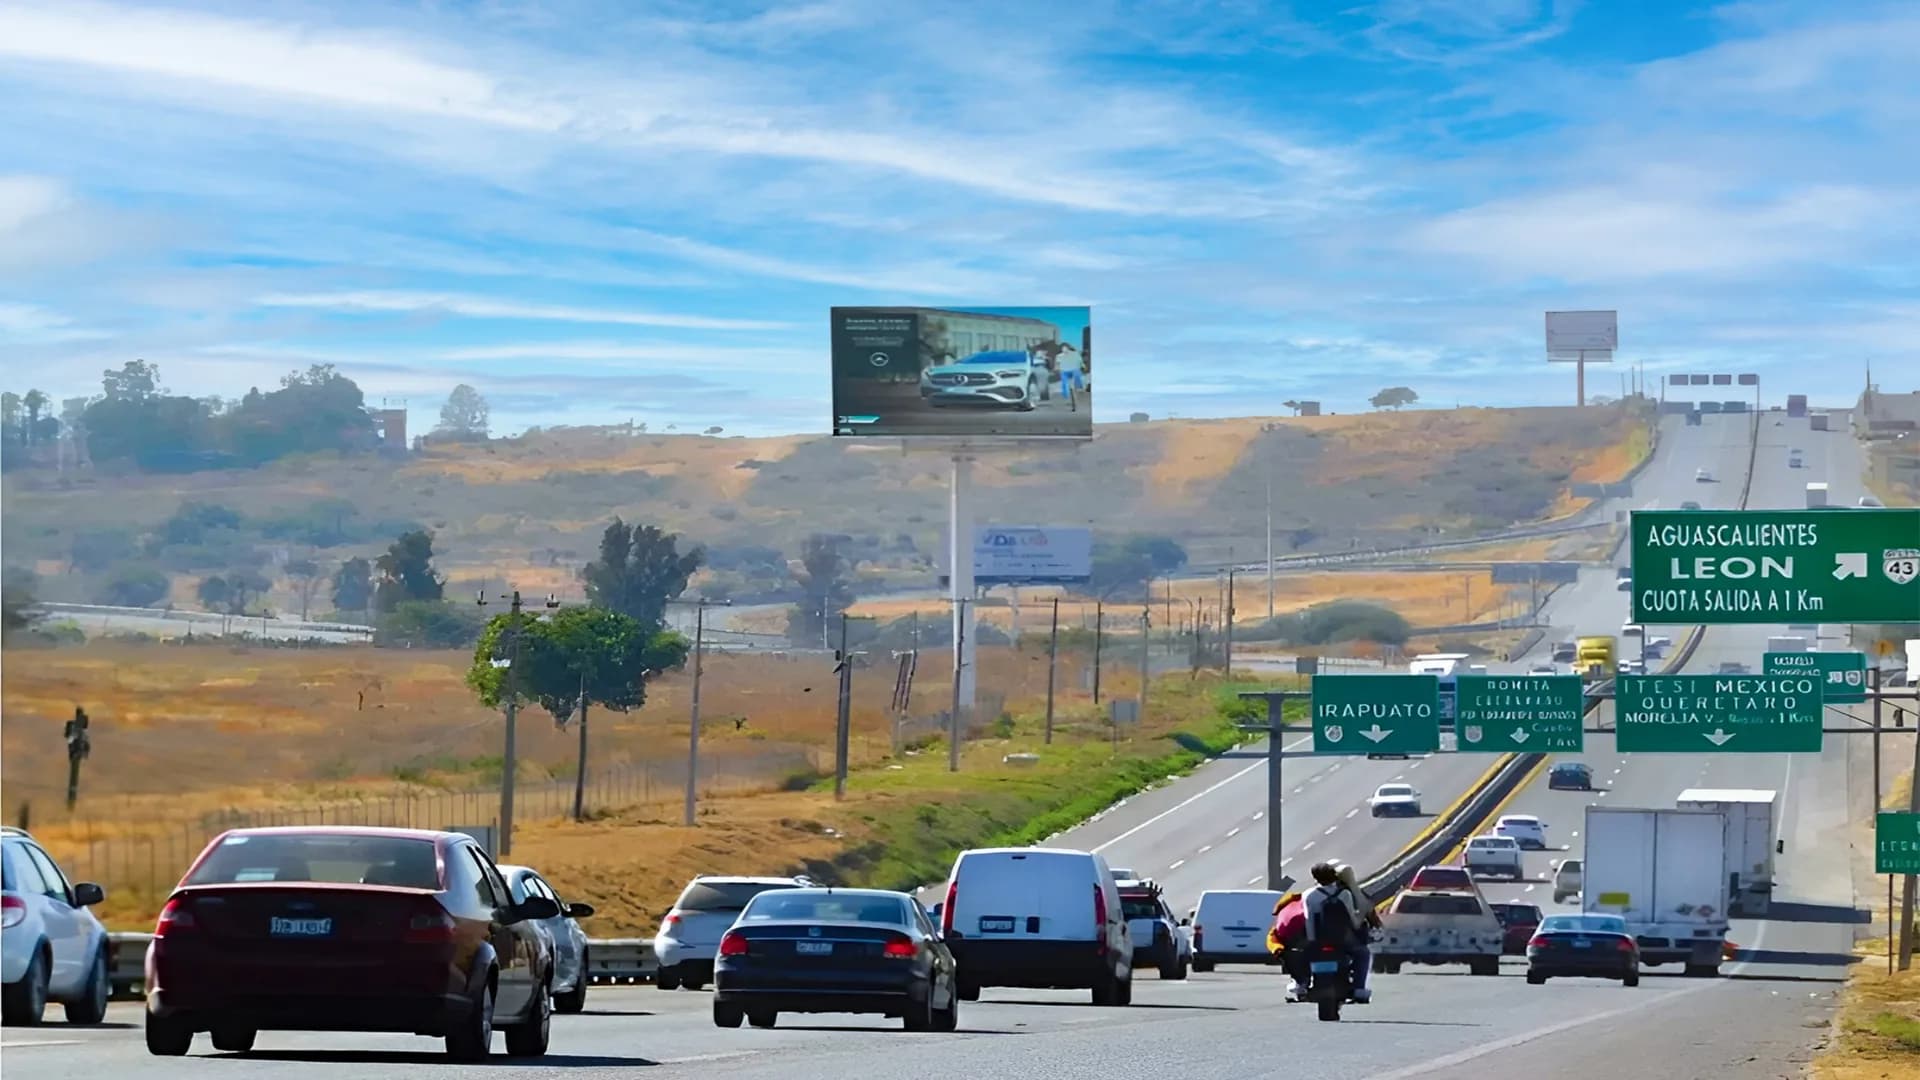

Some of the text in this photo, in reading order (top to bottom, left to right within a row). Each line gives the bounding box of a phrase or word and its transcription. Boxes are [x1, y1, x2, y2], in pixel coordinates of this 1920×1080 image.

[1647, 524, 1817, 546] AGUASCALIENTES
[1671, 556, 1793, 579] LEON
[1889, 561, 1914, 575] 43
[1642, 589, 1823, 611] CUOTA SALIDA A 1 Km
[1716, 679, 1813, 694] MEXICO
[1319, 703, 1431, 718] IRAPUATO
